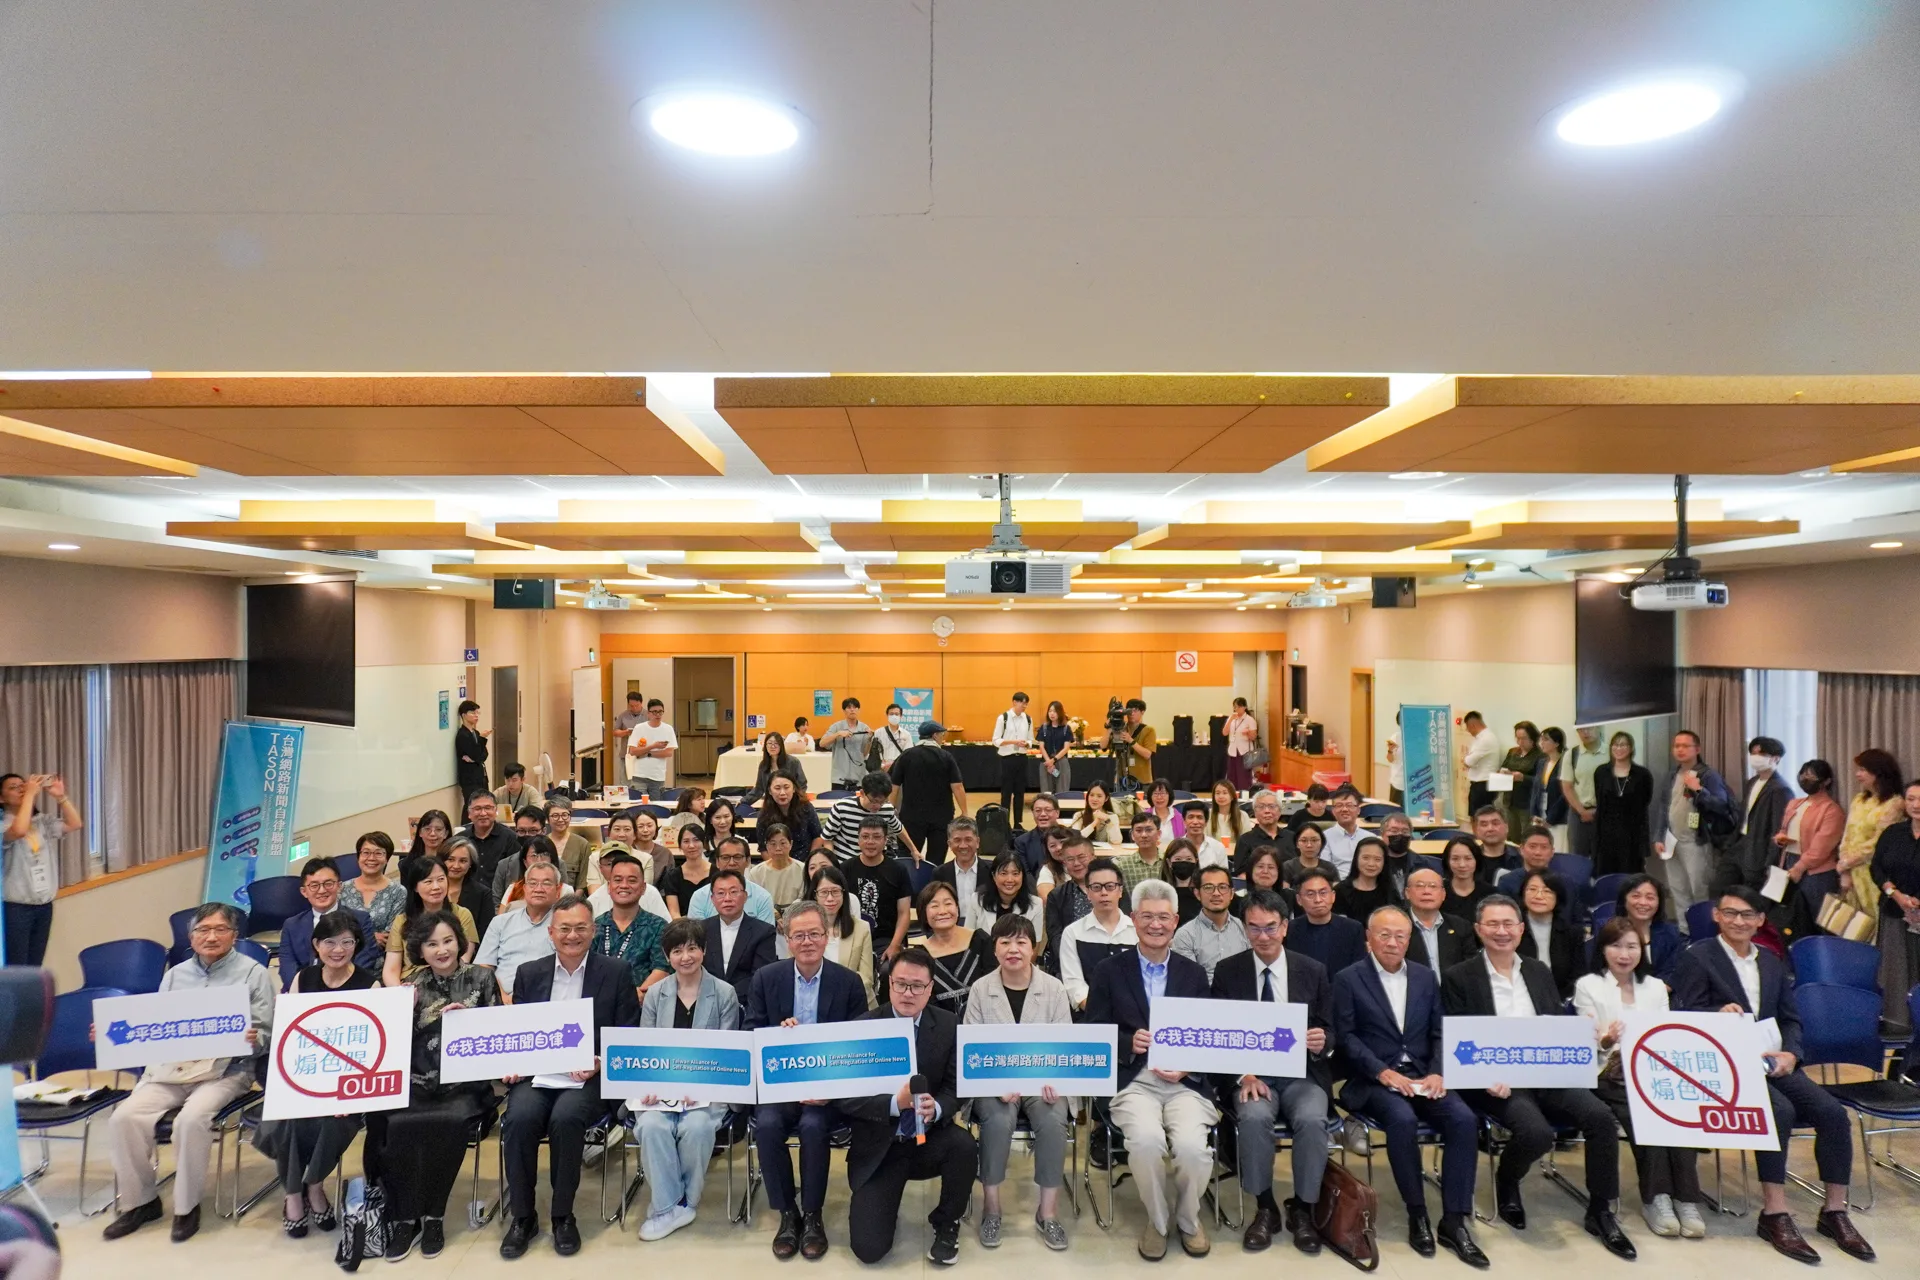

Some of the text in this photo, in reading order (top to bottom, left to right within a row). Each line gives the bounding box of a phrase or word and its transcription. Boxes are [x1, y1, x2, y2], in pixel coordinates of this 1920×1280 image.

[1429, 710, 1438, 754] TASON
[263, 732, 280, 793] TASON
[269, 734, 296, 856] 台灣網路新聞自律聯盟
[296, 1024, 369, 1049] 假新聞
[447, 1031, 564, 1056] #我支持新聞自律
[1155, 1029, 1275, 1050] #我支持新聞自律
[293, 1050, 368, 1076] 煽色腥
[625, 1056, 670, 1070] TASON
[780, 1055, 827, 1070] TASON
[983, 1053, 1107, 1068] 台灣網路新聞自律聯盟
[1647, 1049, 1719, 1073] 假新聞
[342, 1074, 396, 1097] OUT!
[1651, 1077, 1724, 1102] 煽色腥
[1705, 1110, 1760, 1131] OUT!
